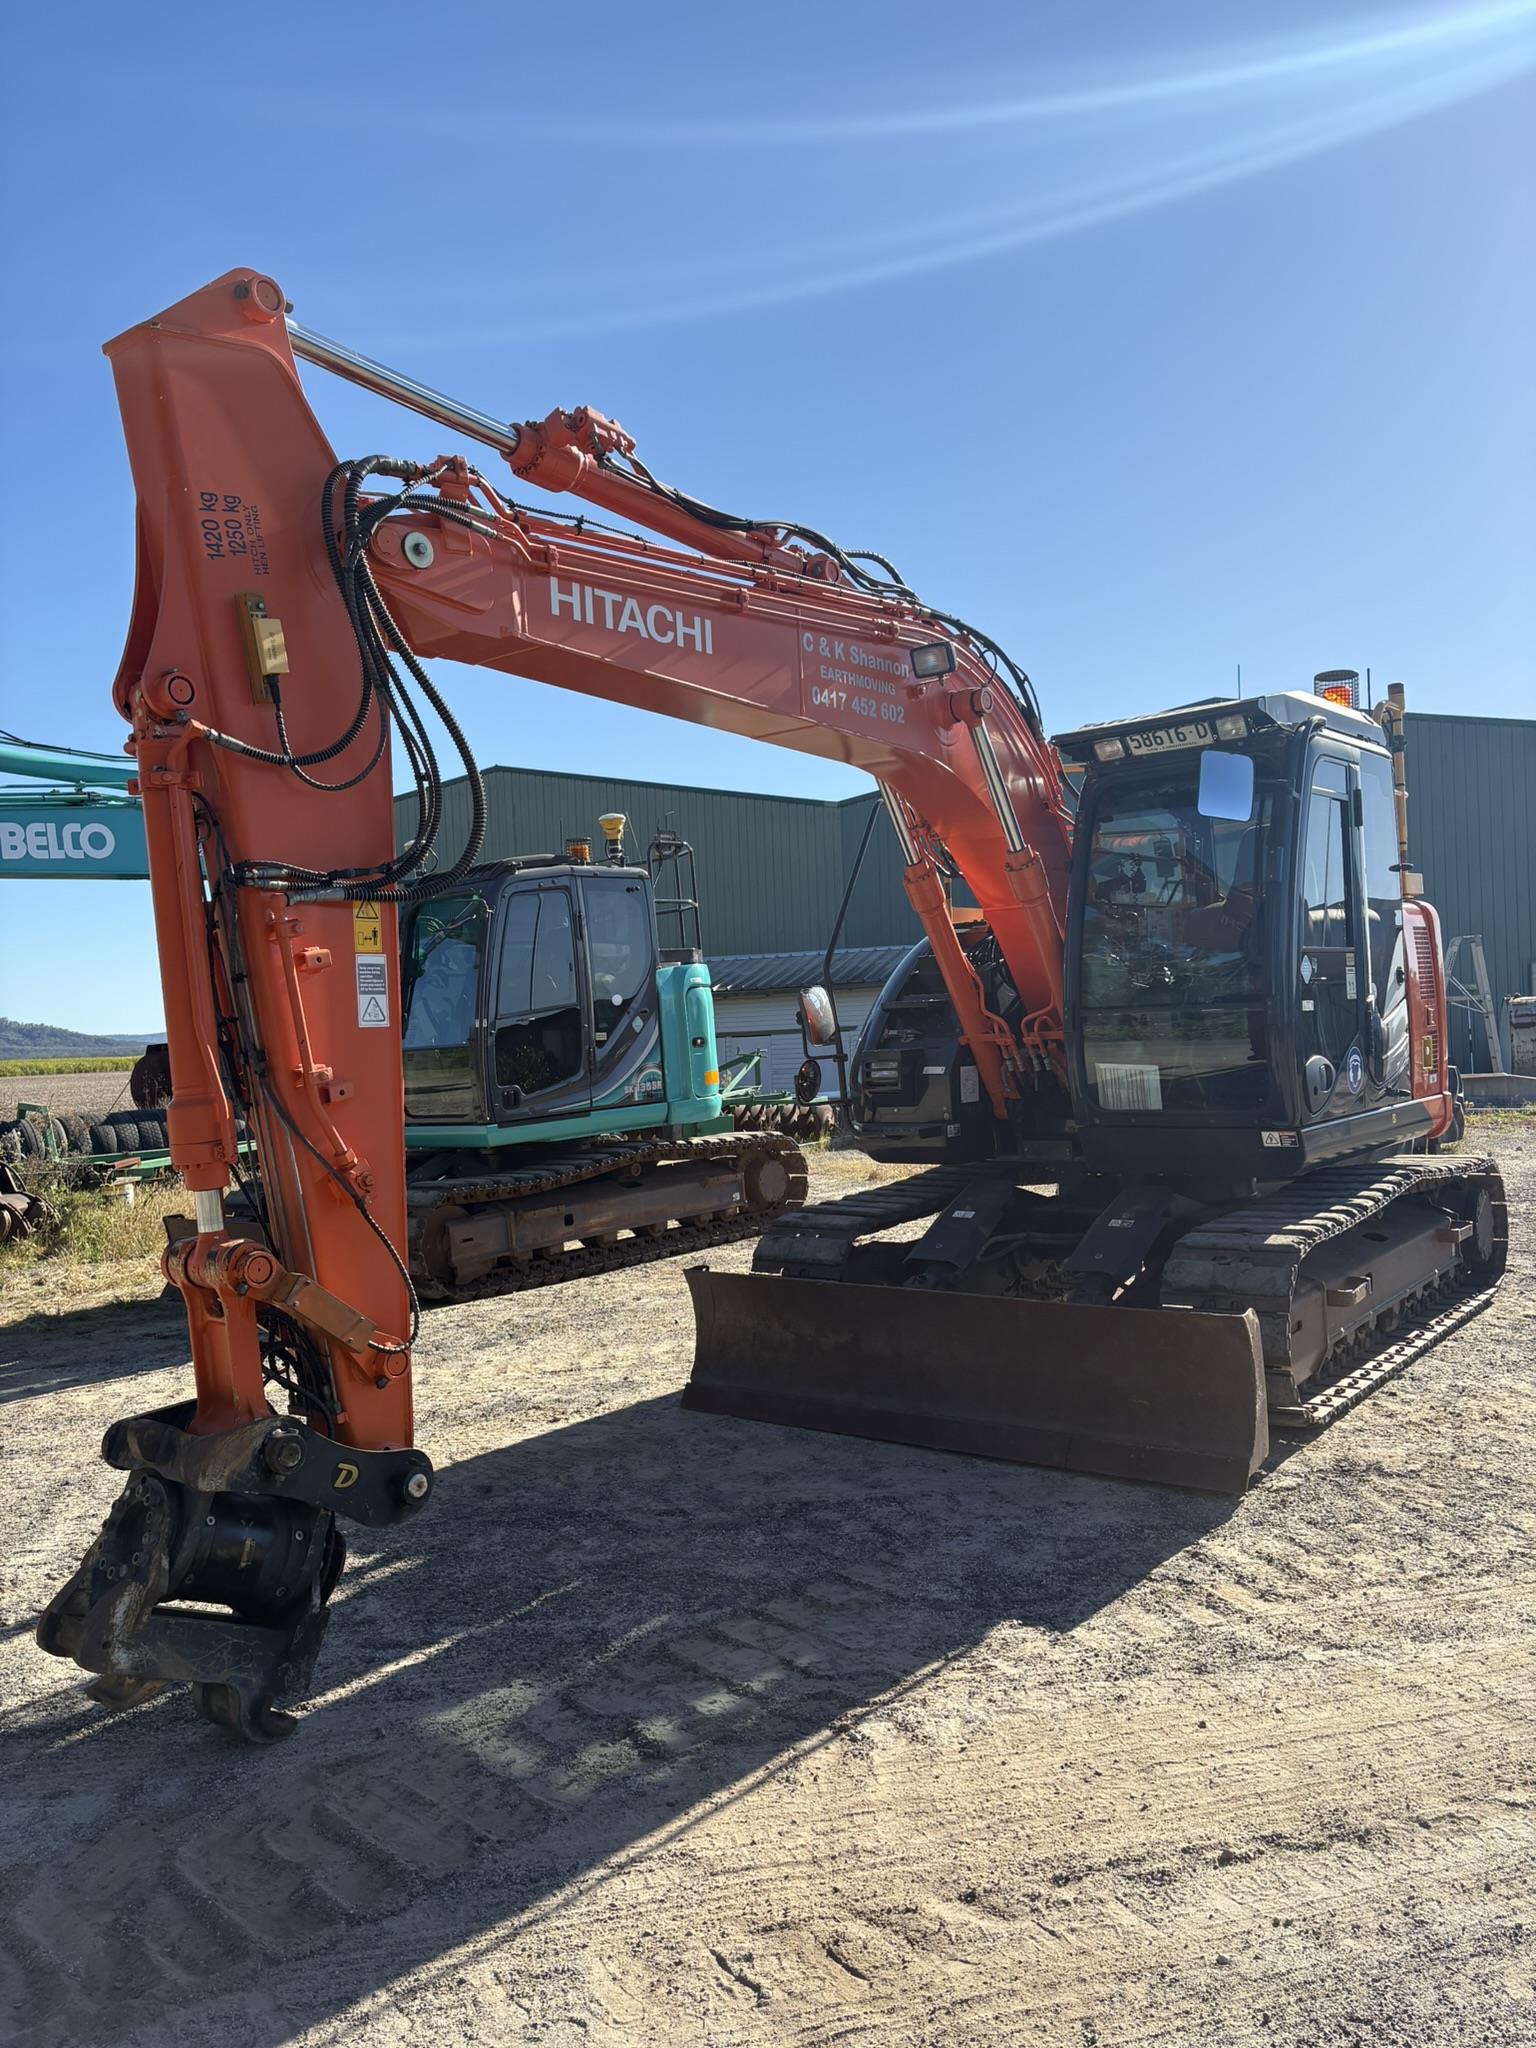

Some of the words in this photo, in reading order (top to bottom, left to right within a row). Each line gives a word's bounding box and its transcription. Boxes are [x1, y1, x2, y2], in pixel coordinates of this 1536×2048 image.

[199, 491, 218, 513] kg
[222, 494, 242, 513] kg
[242, 504, 255, 536] ONLY
[201, 519, 225, 561] 1420
[224, 519, 248, 557] 1250
[251, 505, 265, 548] LIFTING
[249, 540, 262, 576] HITCH
[549, 575, 713, 655] HITACHI
[802, 631, 814, 653] C
[819, 636, 831, 658] &
[834, 640, 846, 661] K
[850, 645, 910, 678] Shannon
[820, 664, 896, 696] EARTHMOVING
[811, 685, 848, 711] 0417
[852, 695, 878, 718] 452
[880, 702, 906, 724] 602
[0, 822, 116, 860] BELCO
